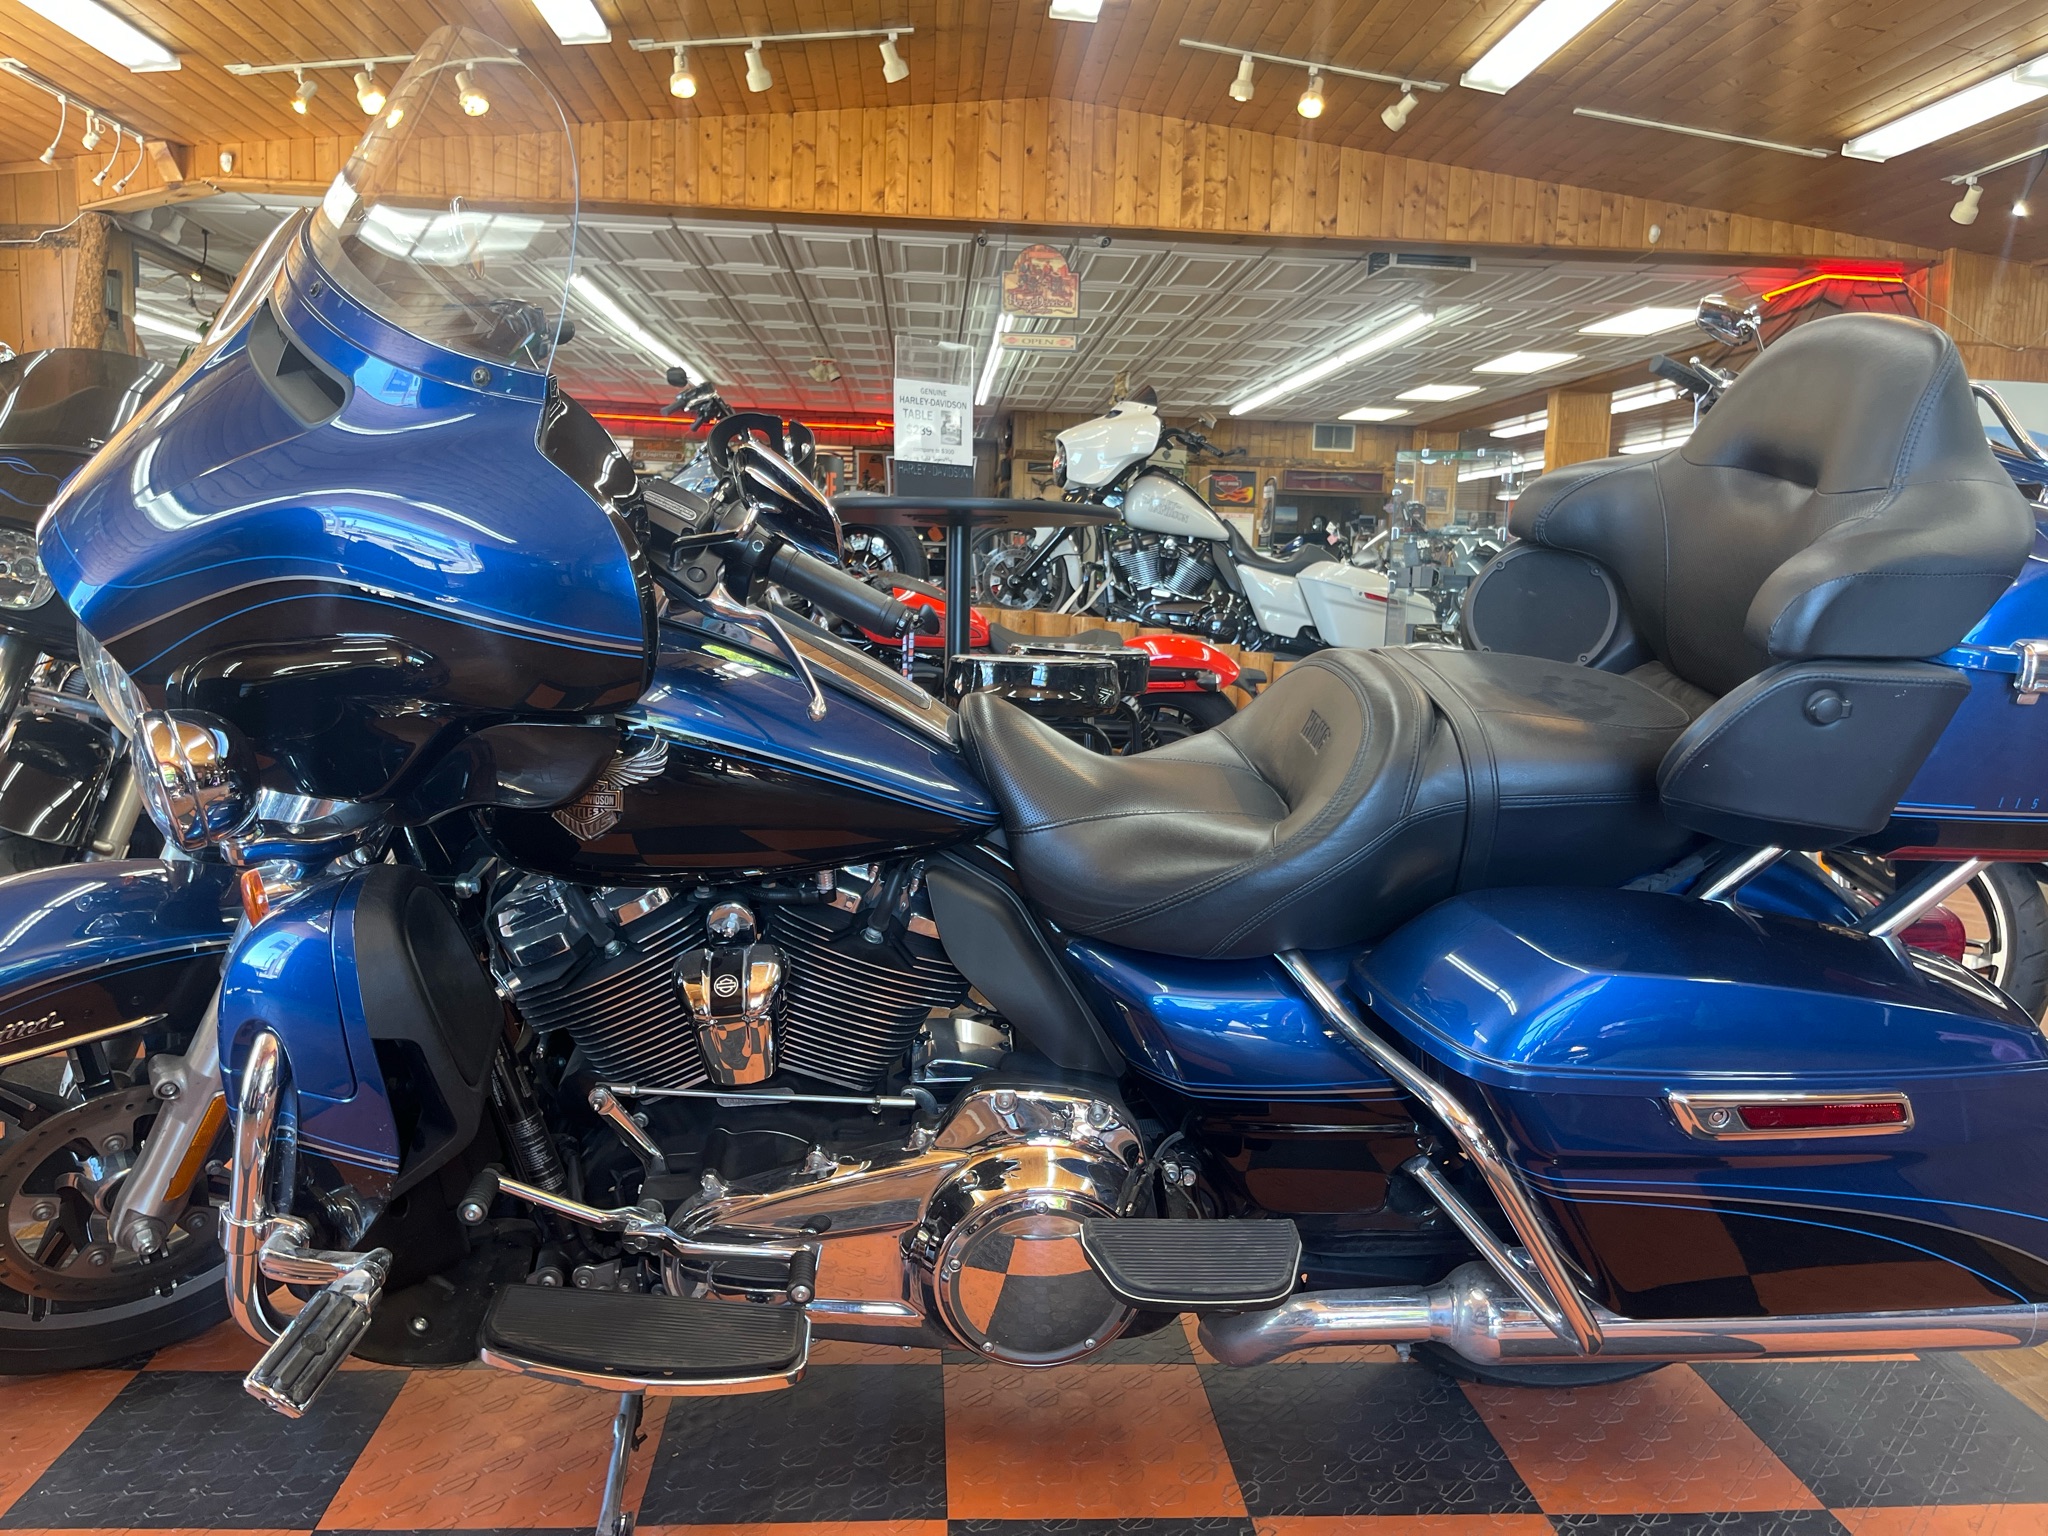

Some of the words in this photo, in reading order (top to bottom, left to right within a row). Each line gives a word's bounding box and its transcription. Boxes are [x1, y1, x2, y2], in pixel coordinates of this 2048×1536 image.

[920, 387, 947, 396] GENUINE
[899, 395, 967, 410] HARLEY-DAVIDSON
[903, 408, 933, 421] TABLE
